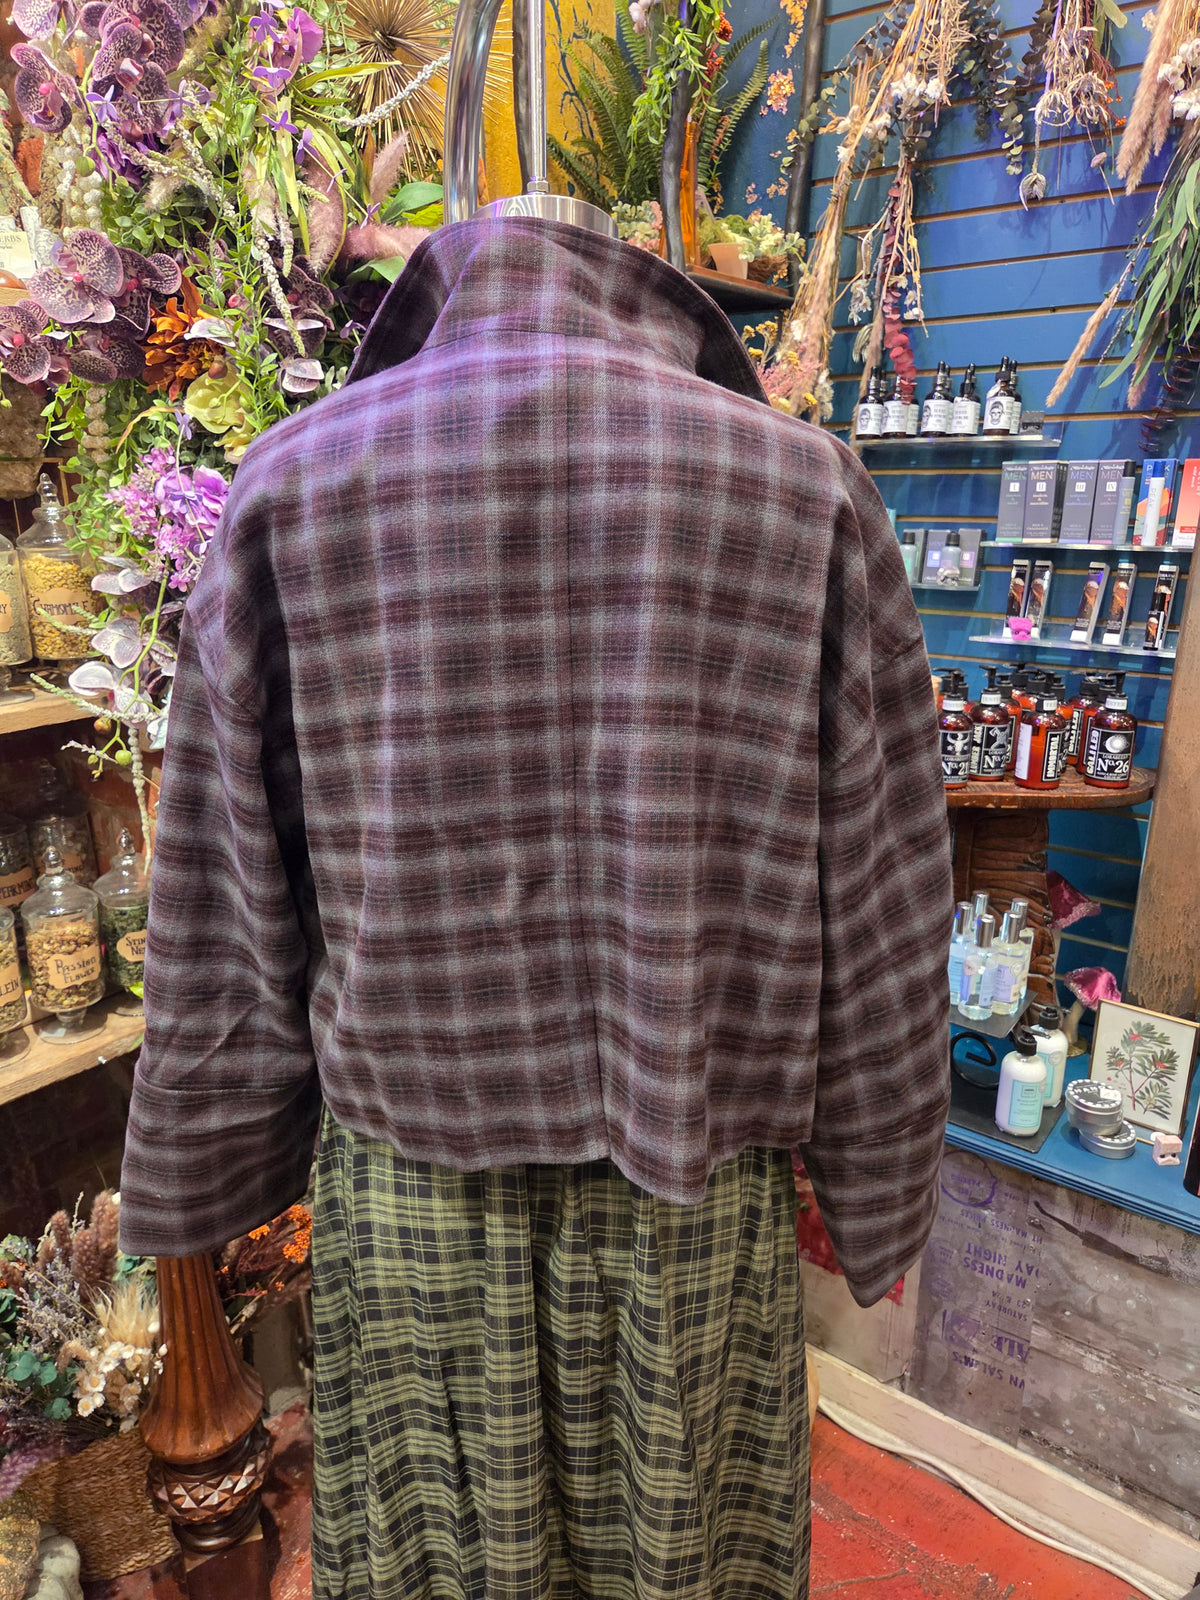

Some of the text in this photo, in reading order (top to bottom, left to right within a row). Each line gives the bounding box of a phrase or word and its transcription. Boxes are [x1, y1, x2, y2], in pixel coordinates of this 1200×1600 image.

[1031, 471, 1053, 480] MEN
[1070, 471, 1094, 480] MEN
[1113, 760, 1130, 773] 26
[965, 1242, 1007, 1267] NIGHT
[963, 1256, 1027, 1289] MADNESS
